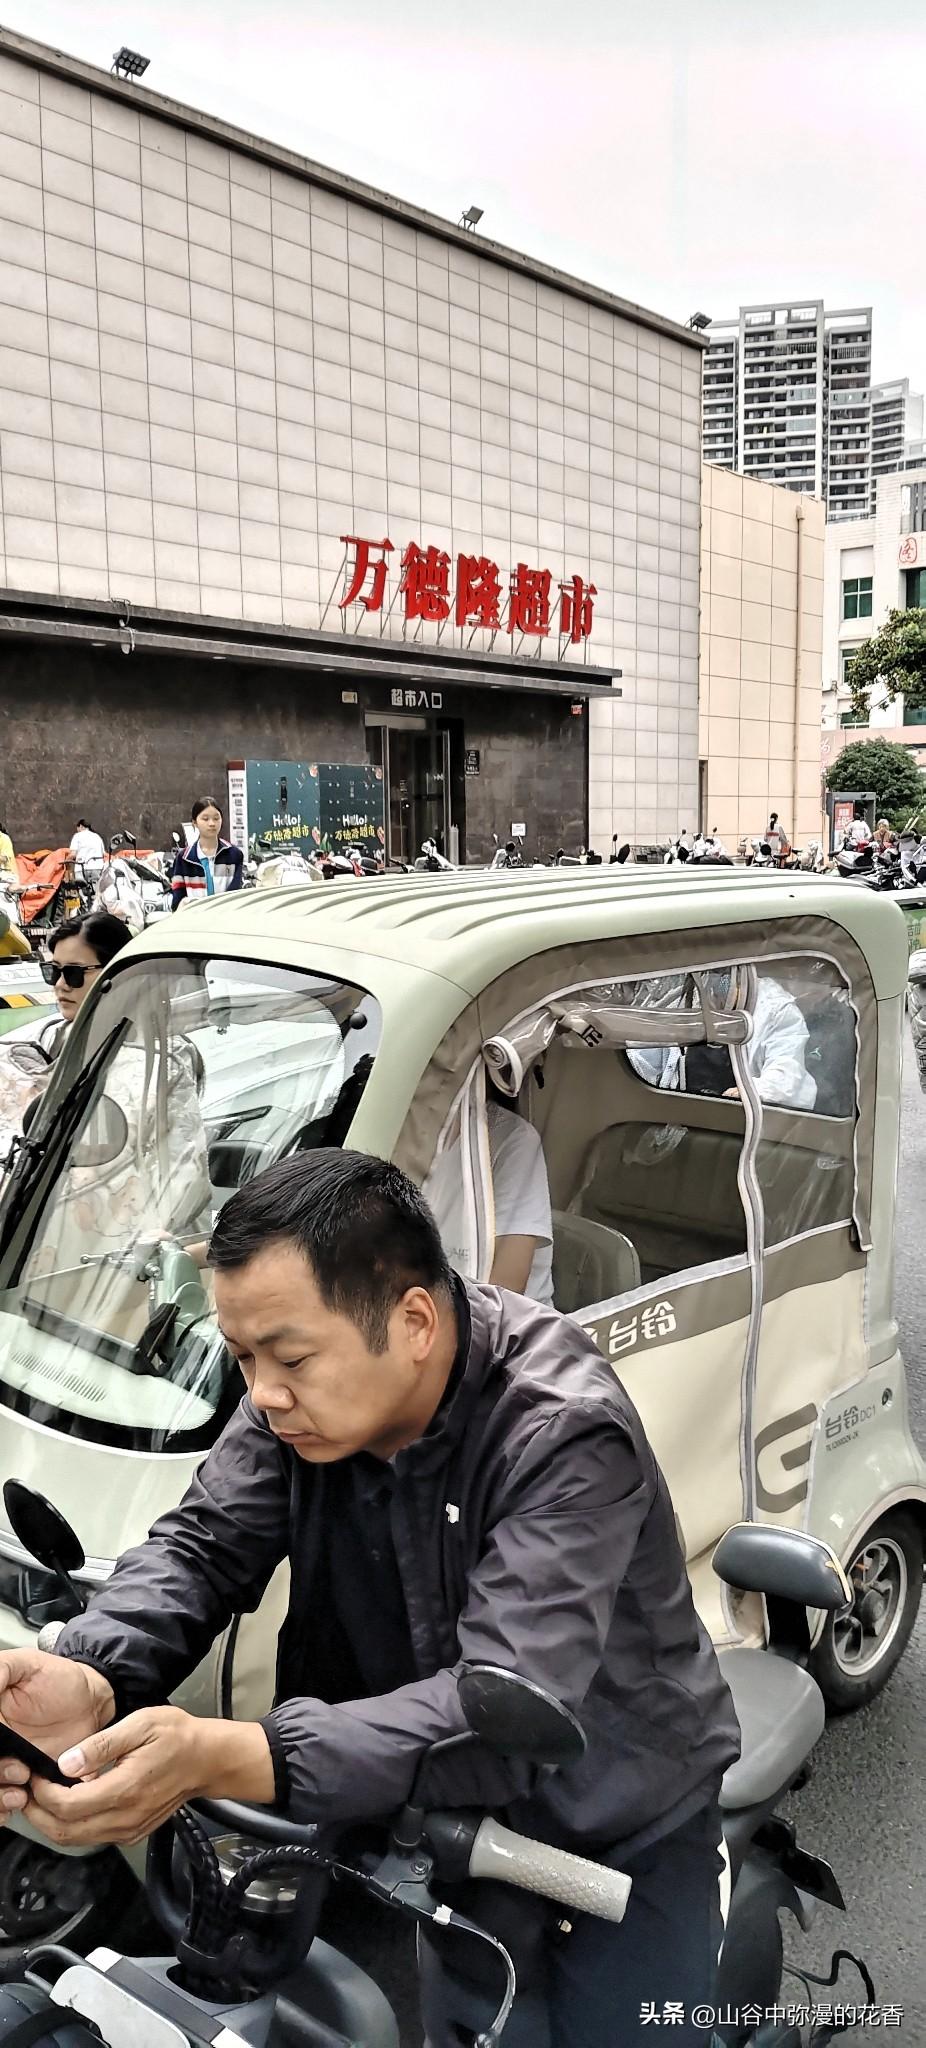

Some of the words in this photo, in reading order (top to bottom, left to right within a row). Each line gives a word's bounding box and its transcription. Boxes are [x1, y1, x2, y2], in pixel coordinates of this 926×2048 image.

[338, 534, 598, 644] 万德隆超市
[391, 688, 442, 709] 超市入口
[263, 824, 309, 841] 万德隆超市
[608, 1300, 677, 1355] 台铃
